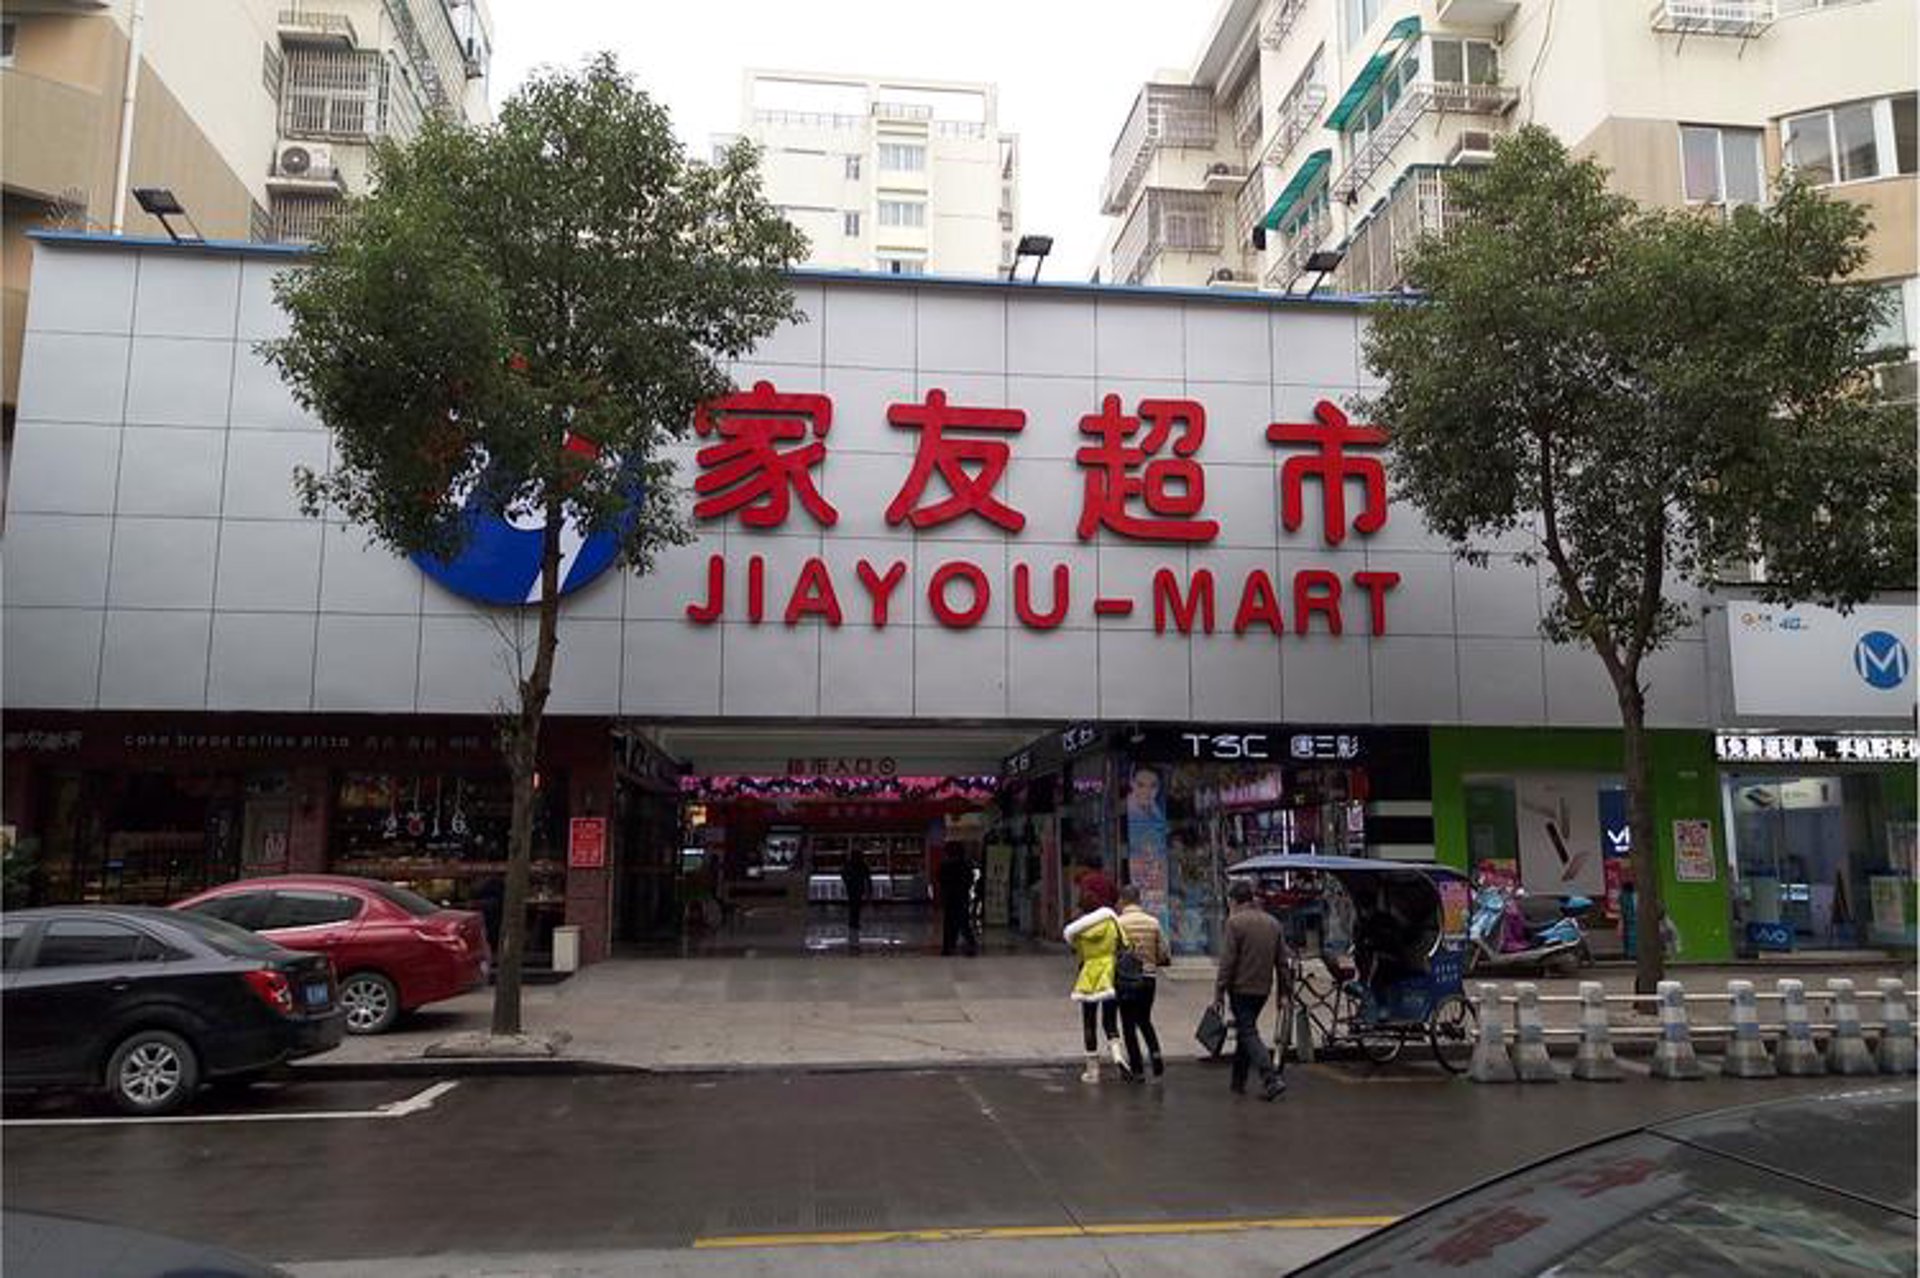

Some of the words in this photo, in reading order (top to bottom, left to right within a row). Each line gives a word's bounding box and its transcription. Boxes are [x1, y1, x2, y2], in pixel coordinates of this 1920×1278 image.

[694, 381, 1391, 545] 家友超市
[687, 554, 1401, 636] JIAYOU-MART
